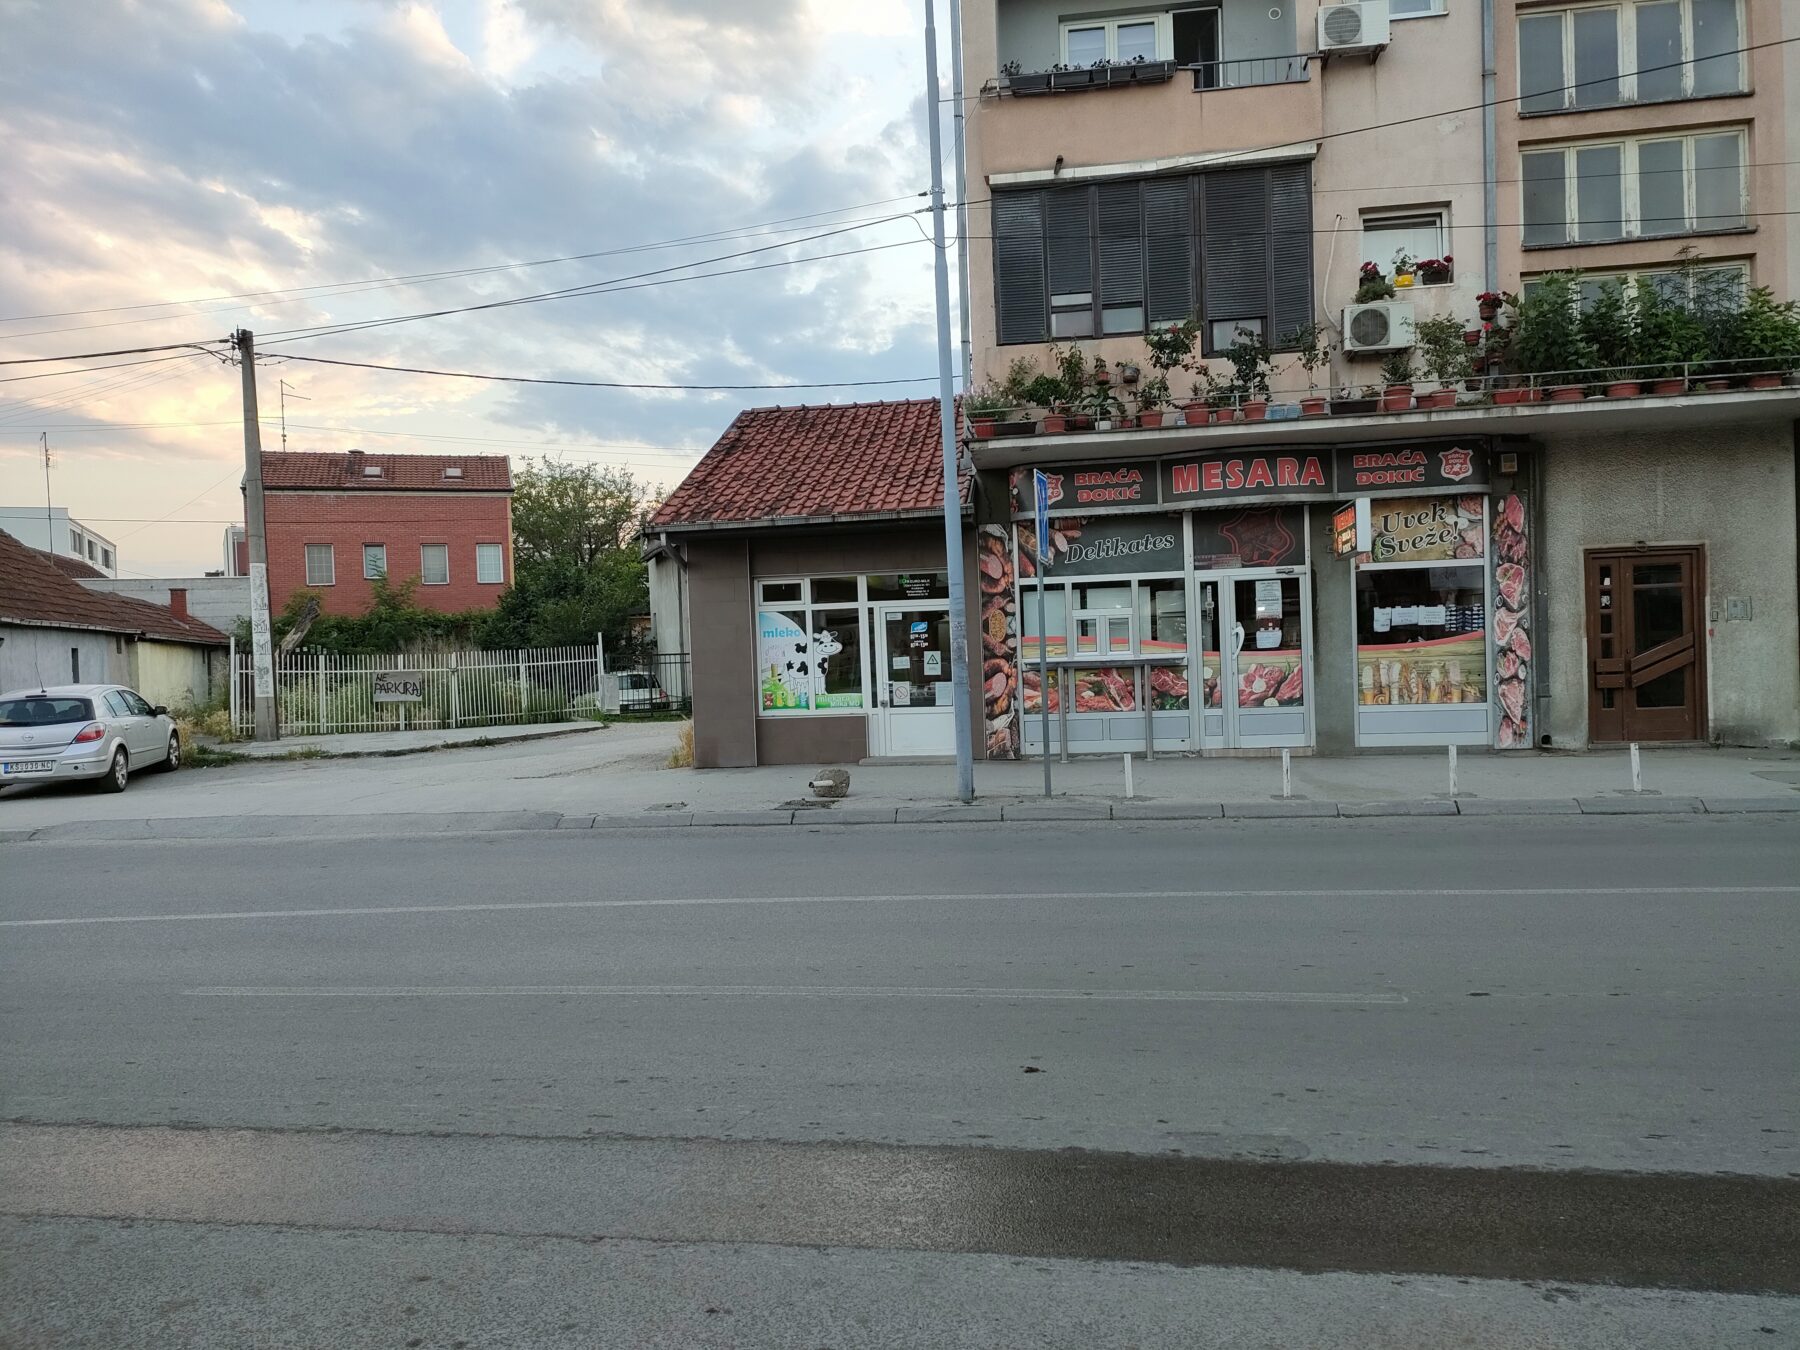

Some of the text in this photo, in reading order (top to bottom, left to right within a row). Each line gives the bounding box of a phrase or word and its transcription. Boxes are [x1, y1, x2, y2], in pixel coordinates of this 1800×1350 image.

[1353, 449, 1428, 468] BRAĆA
[1074, 468, 1143, 486] BRAĆA
[1172, 457, 1325, 494] MESARA
[1356, 465, 1425, 485] ĐOKIĆ
[1077, 484, 1140, 502] ĐOKIĆ
[1381, 502, 1447, 533] Uvek
[1064, 534, 1175, 564] Delikates
[1379, 520, 1459, 559] Sveže!
[762, 627, 801, 638] mleko
[375, 673, 389, 682] NE
